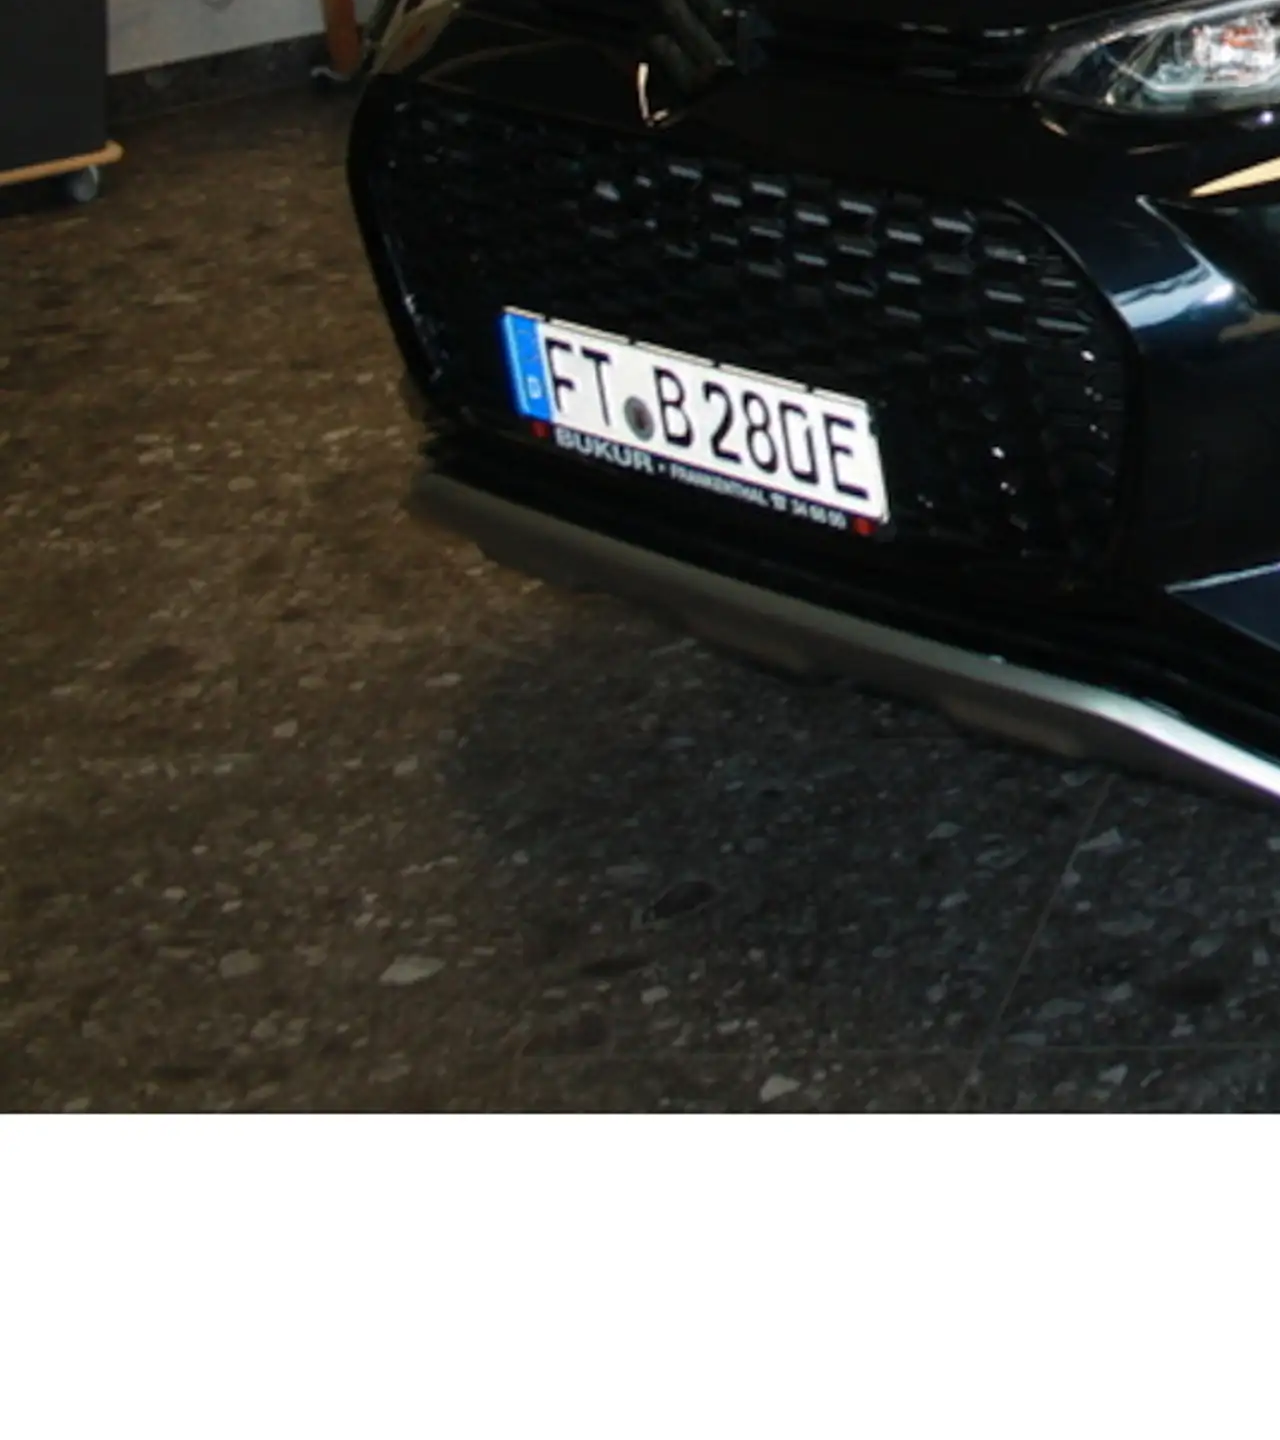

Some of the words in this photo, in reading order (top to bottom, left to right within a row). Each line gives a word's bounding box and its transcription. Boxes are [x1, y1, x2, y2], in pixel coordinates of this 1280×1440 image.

[544, 336, 614, 427] FT
[654, 367, 694, 448] B
[554, 426, 655, 476] BUKUR
